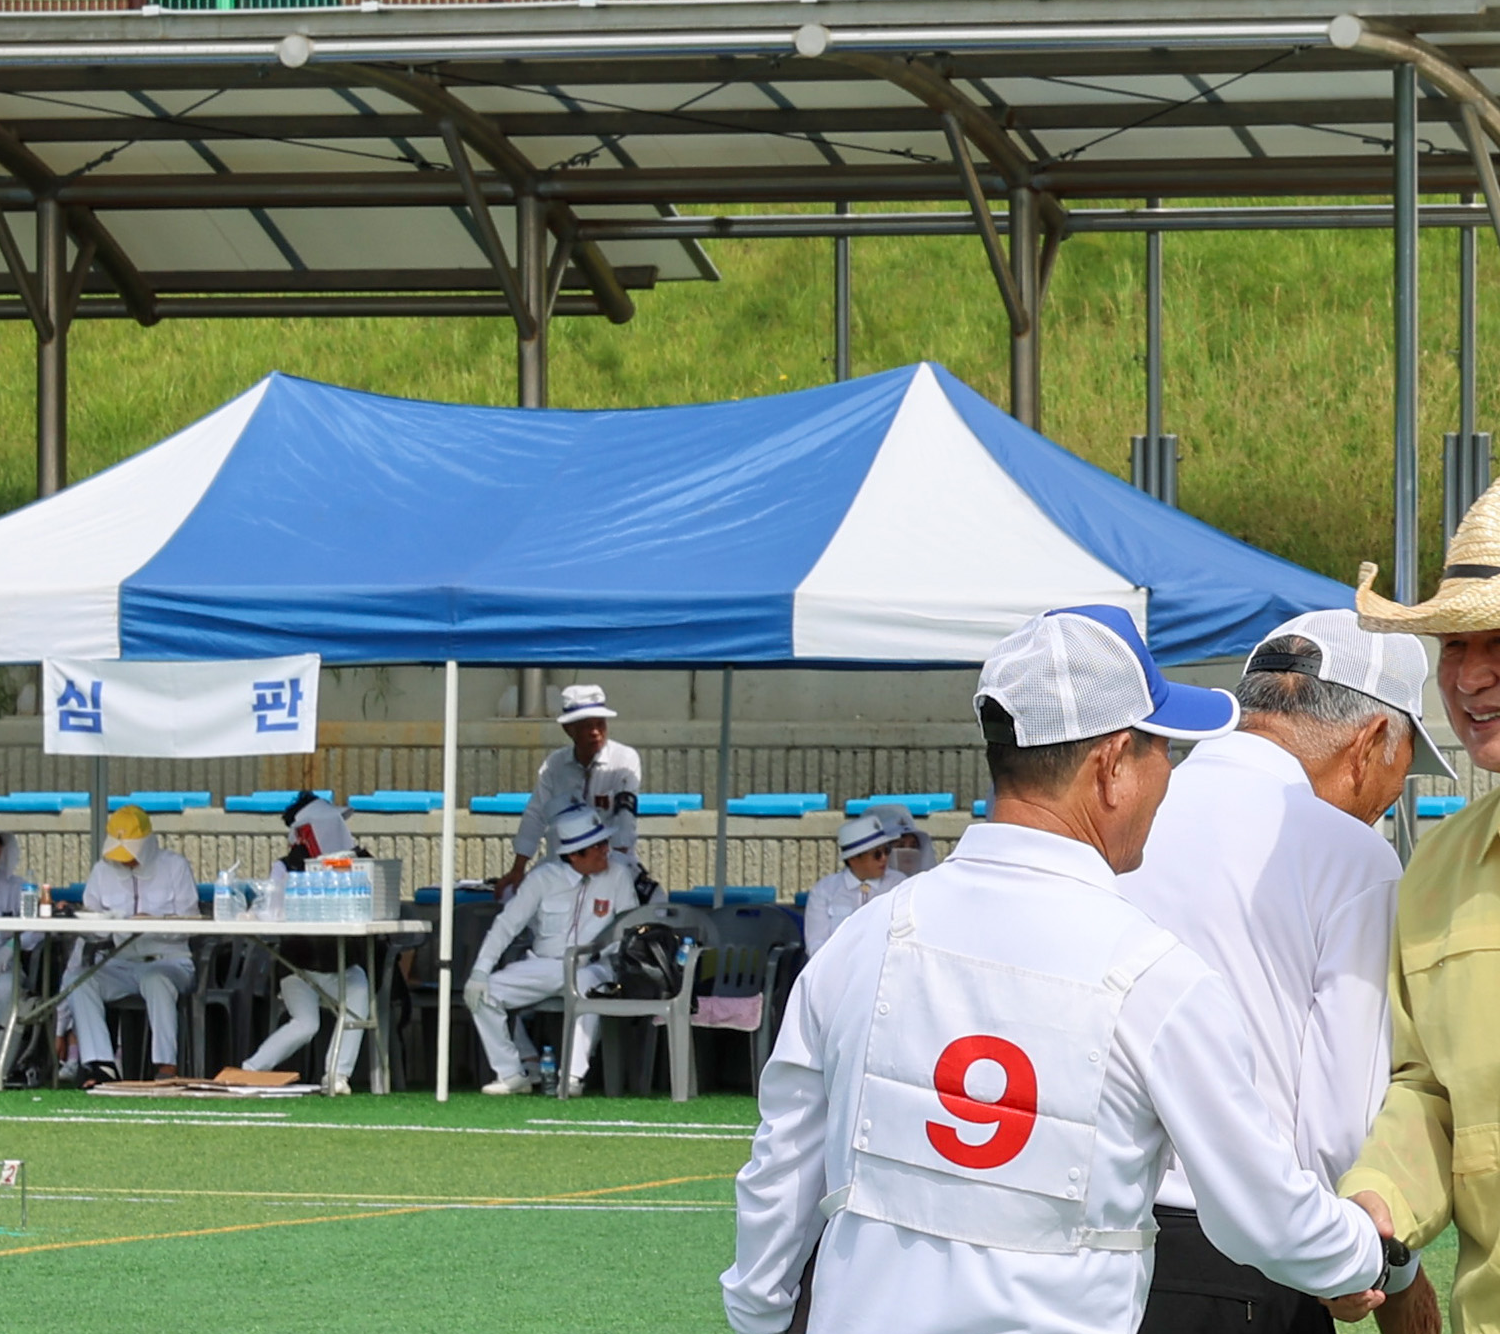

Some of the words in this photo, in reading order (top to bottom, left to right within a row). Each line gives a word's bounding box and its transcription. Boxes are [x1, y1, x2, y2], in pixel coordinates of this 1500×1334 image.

[57, 680, 103, 734] 심
[252, 678, 303, 733] 판
[925, 1035, 1038, 1170] 9
